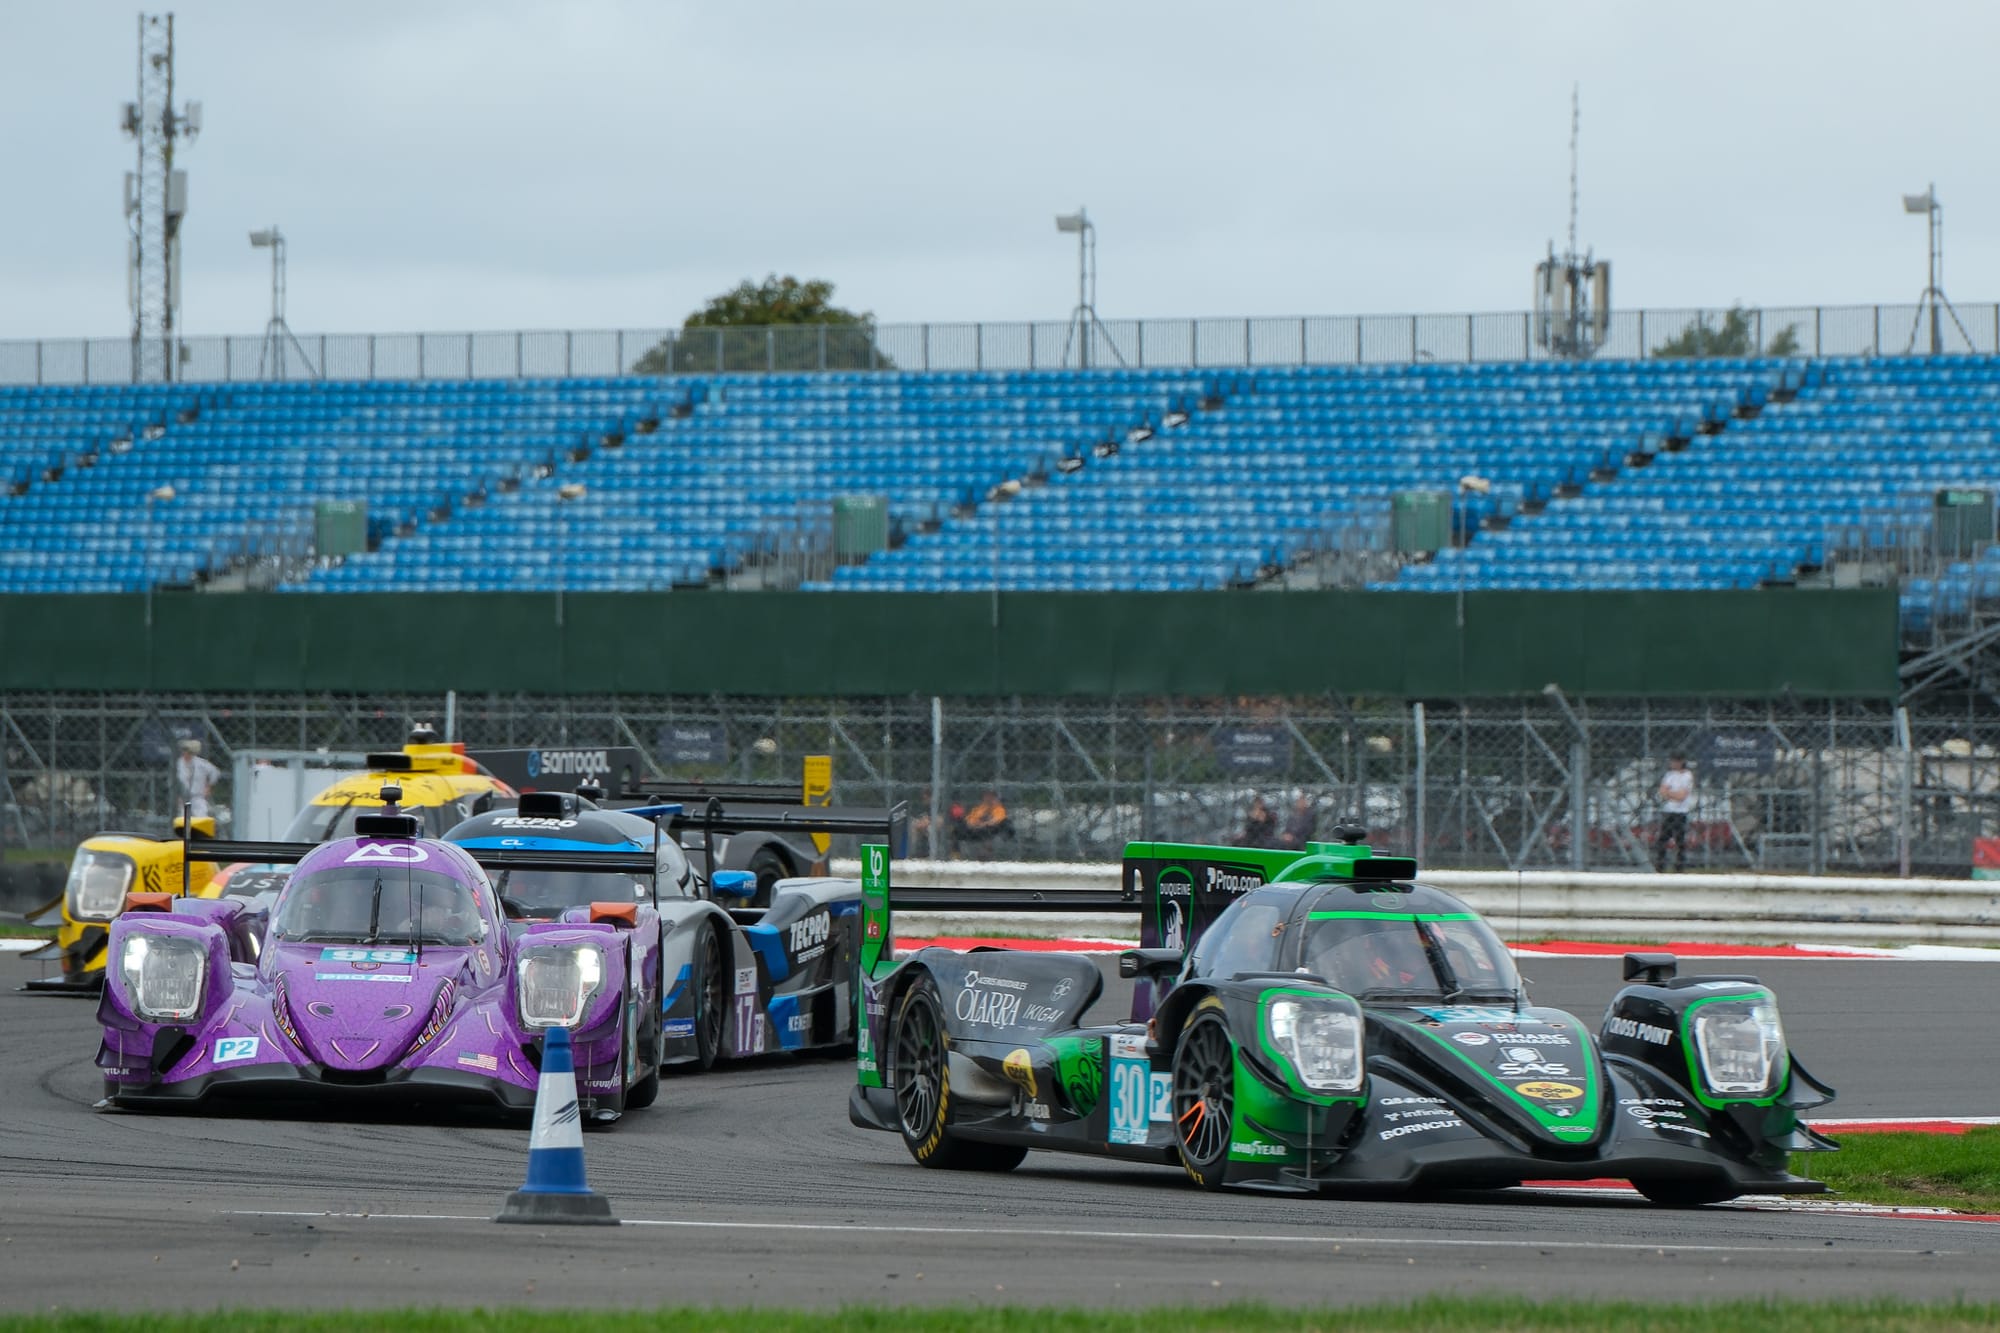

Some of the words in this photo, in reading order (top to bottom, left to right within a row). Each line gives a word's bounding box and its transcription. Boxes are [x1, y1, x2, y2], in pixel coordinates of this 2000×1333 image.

[491, 816, 578, 829] TECPRO
[1159, 882, 1192, 897] DUQUEINE
[790, 910, 831, 953] TECPRO
[331, 949, 407, 962] 99
[1022, 1004, 1065, 1023] IKIGAI
[736, 994, 755, 1053] 17
[1610, 1016, 1637, 1040] CROSS
[1637, 1023, 1674, 1046] POINT
[219, 1040, 254, 1059] P2
[1497, 1063, 1571, 1076] SAS
[1113, 1063, 1146, 1129] 30
[1152, 1080, 1173, 1114] P2
[1402, 1108, 1454, 1118] infinity
[1379, 1119, 1463, 1141] BORNCUT
[1231, 1140, 1287, 1157] GOODYEAR
